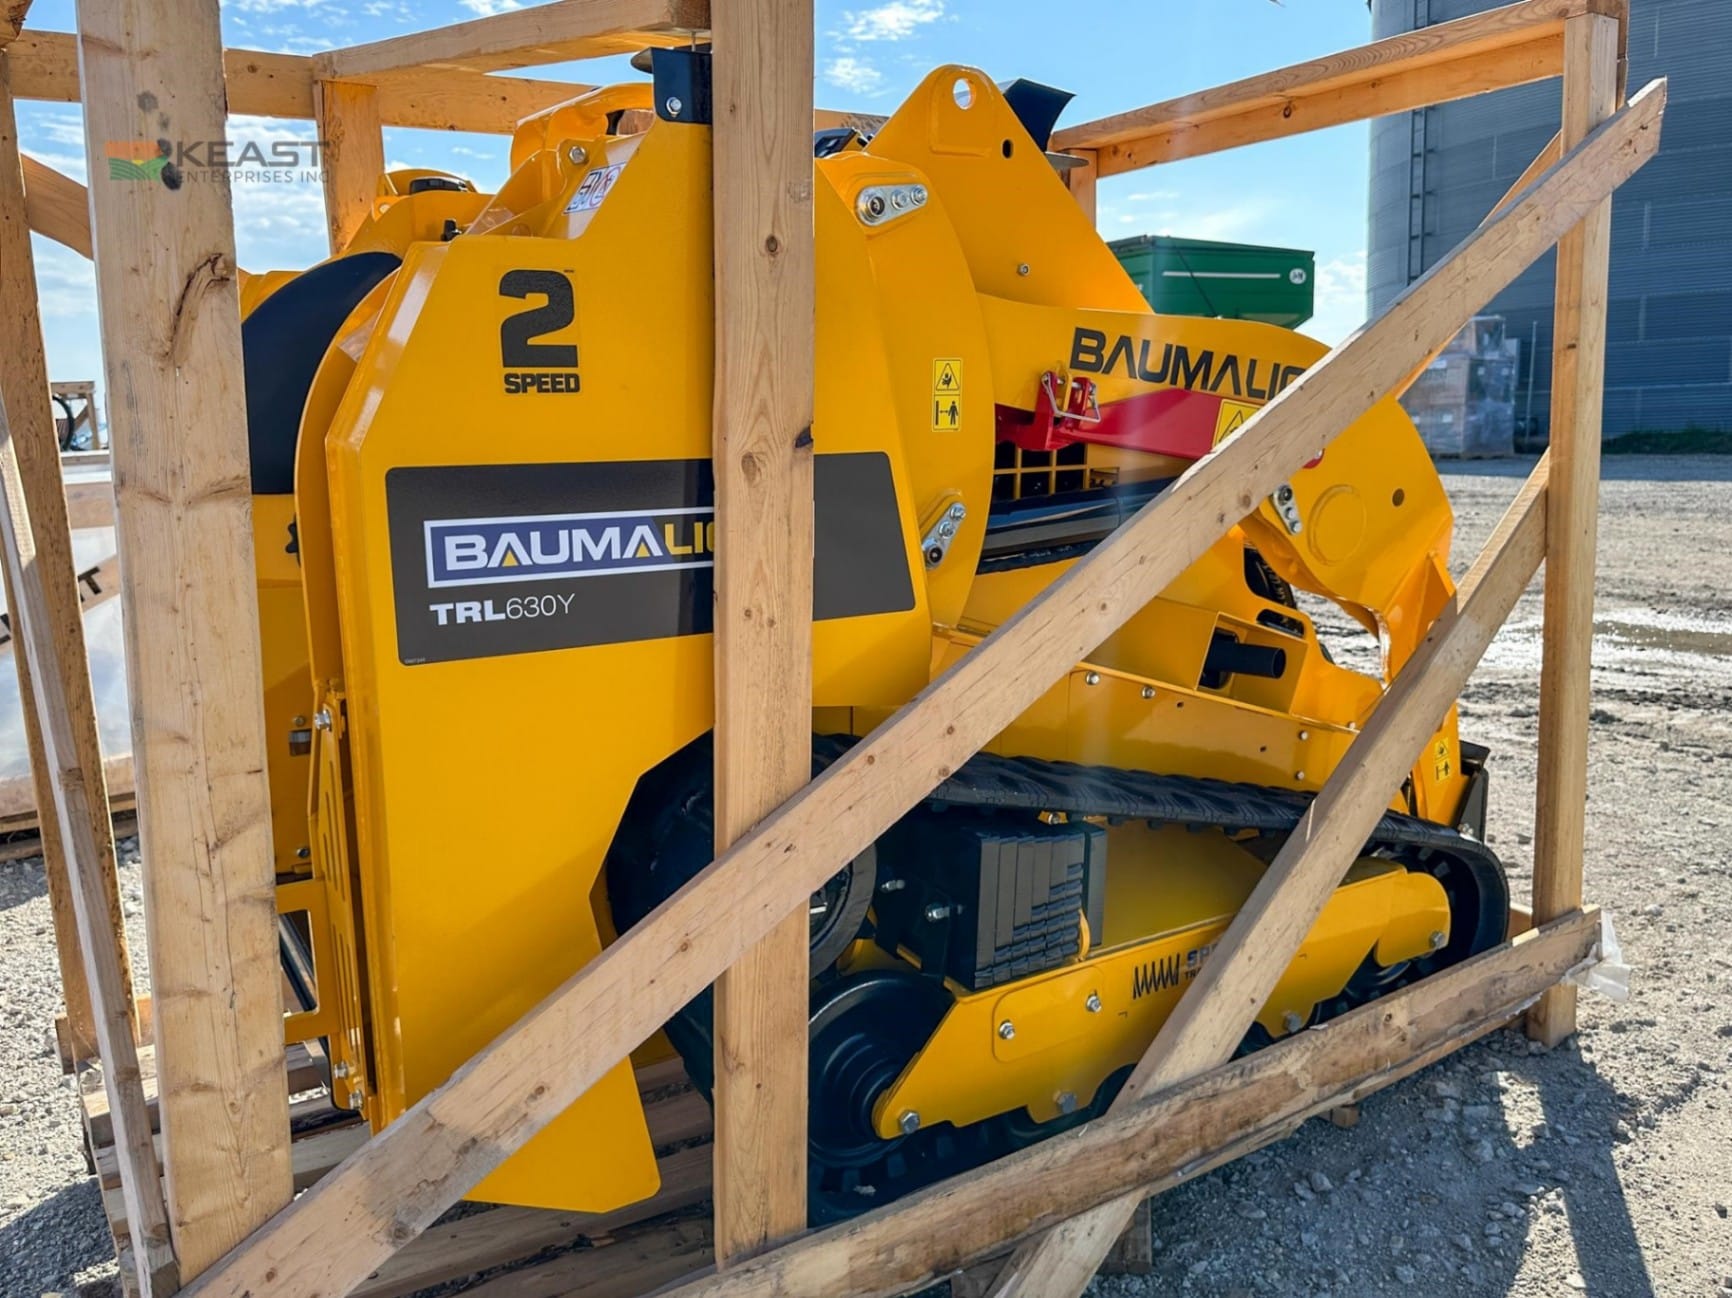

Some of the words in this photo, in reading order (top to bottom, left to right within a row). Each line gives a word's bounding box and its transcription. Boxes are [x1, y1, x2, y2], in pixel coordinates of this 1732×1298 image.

[499, 269, 578, 368] 2
[504, 373, 580, 393] SPEED
[429, 593, 575, 625] TRL630Y
